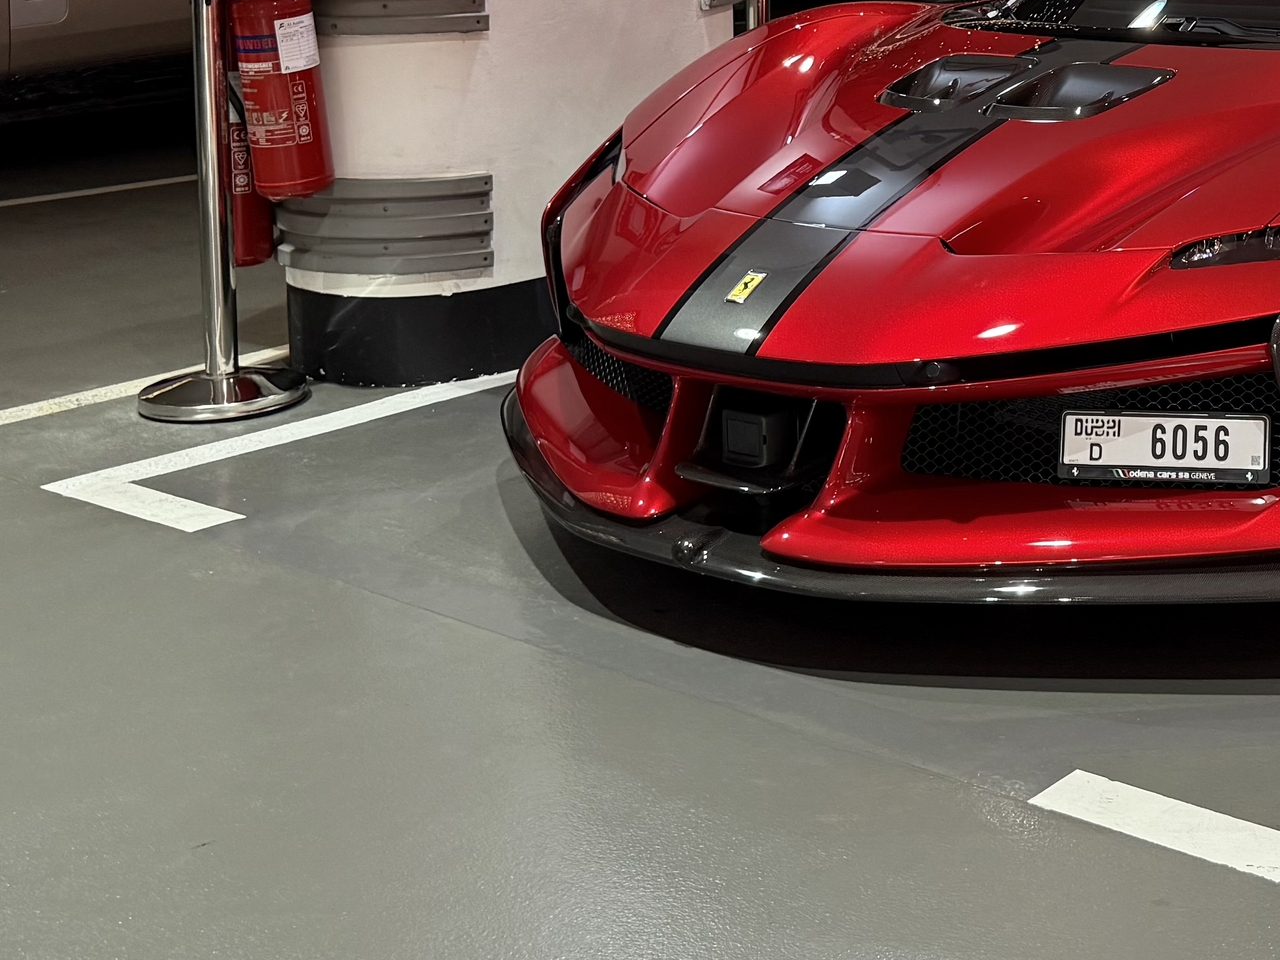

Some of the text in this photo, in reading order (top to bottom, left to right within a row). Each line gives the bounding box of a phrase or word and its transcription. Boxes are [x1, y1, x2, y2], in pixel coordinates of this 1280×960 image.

[1075, 418, 1230, 462] DUBAI 6056
[1089, 443, 1103, 461] D
[1157, 470, 1177, 479] cars
[1178, 471, 1190, 479] sa
